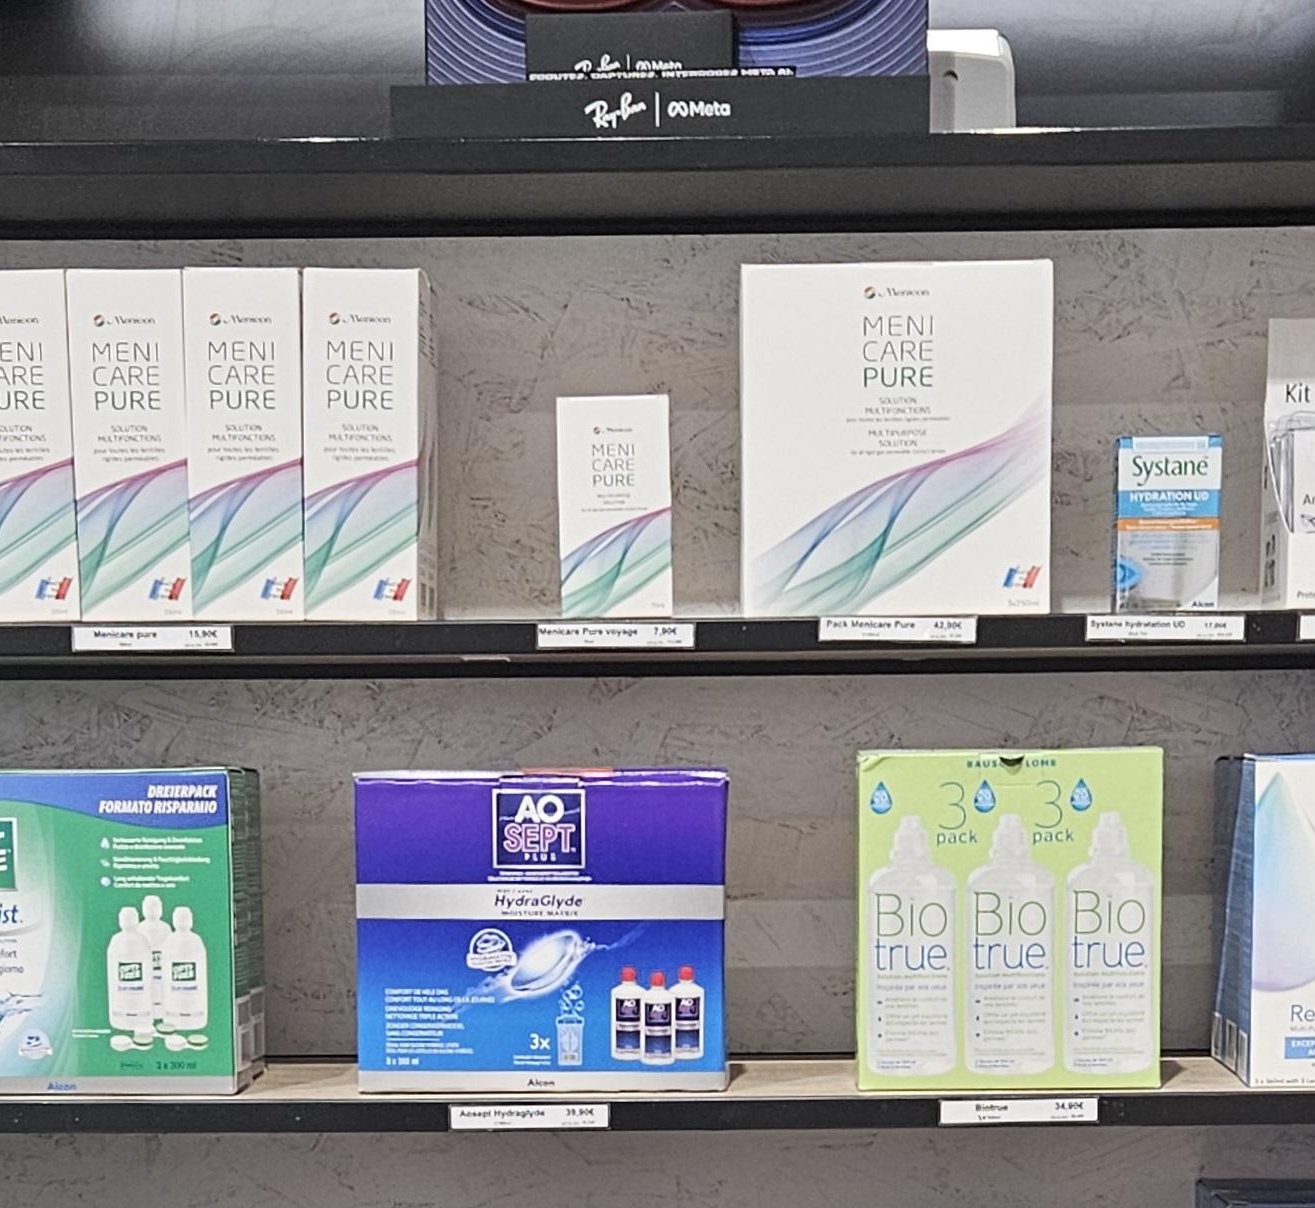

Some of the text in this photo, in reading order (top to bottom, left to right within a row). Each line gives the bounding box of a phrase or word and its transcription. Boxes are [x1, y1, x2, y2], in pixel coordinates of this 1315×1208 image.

[690, 102, 730, 116] Meta
[864, 315, 934, 337] MENI
[92, 342, 159, 362] MENI
[327, 341, 394, 361] MENI
[863, 341, 934, 362] CARE
[93, 366, 159, 386] CARE
[326, 365, 393, 385] CARE
[864, 367, 934, 388] PURE
[95, 390, 161, 410] PURE
[327, 390, 393, 410] PURE
[1285, 384, 1309, 403] Kit
[592, 443, 635, 457] MENI
[592, 459, 635, 472] CARE
[1132, 456, 1208, 486] Systane
[593, 474, 635, 487] PURE
[1130, 491, 1208, 502] HYDRATION UD
[93, 630, 133, 639] Menicare
[137, 631, 157, 641] pure
[605, 628, 638, 638] voyage
[147, 785, 217, 799] DREIERPACK
[99, 800, 217, 814] FORMATO RISPARMIO
[514, 795, 564, 823] AO
[939, 782, 966, 830] 3
[503, 825, 576, 852] SEPT
[936, 830, 978, 846] pack
[494, 894, 583, 909] HydraGlyde
[876, 893, 947, 937] Bio
[876, 938, 947, 971] true
[530, 1035, 550, 1050] 3x
